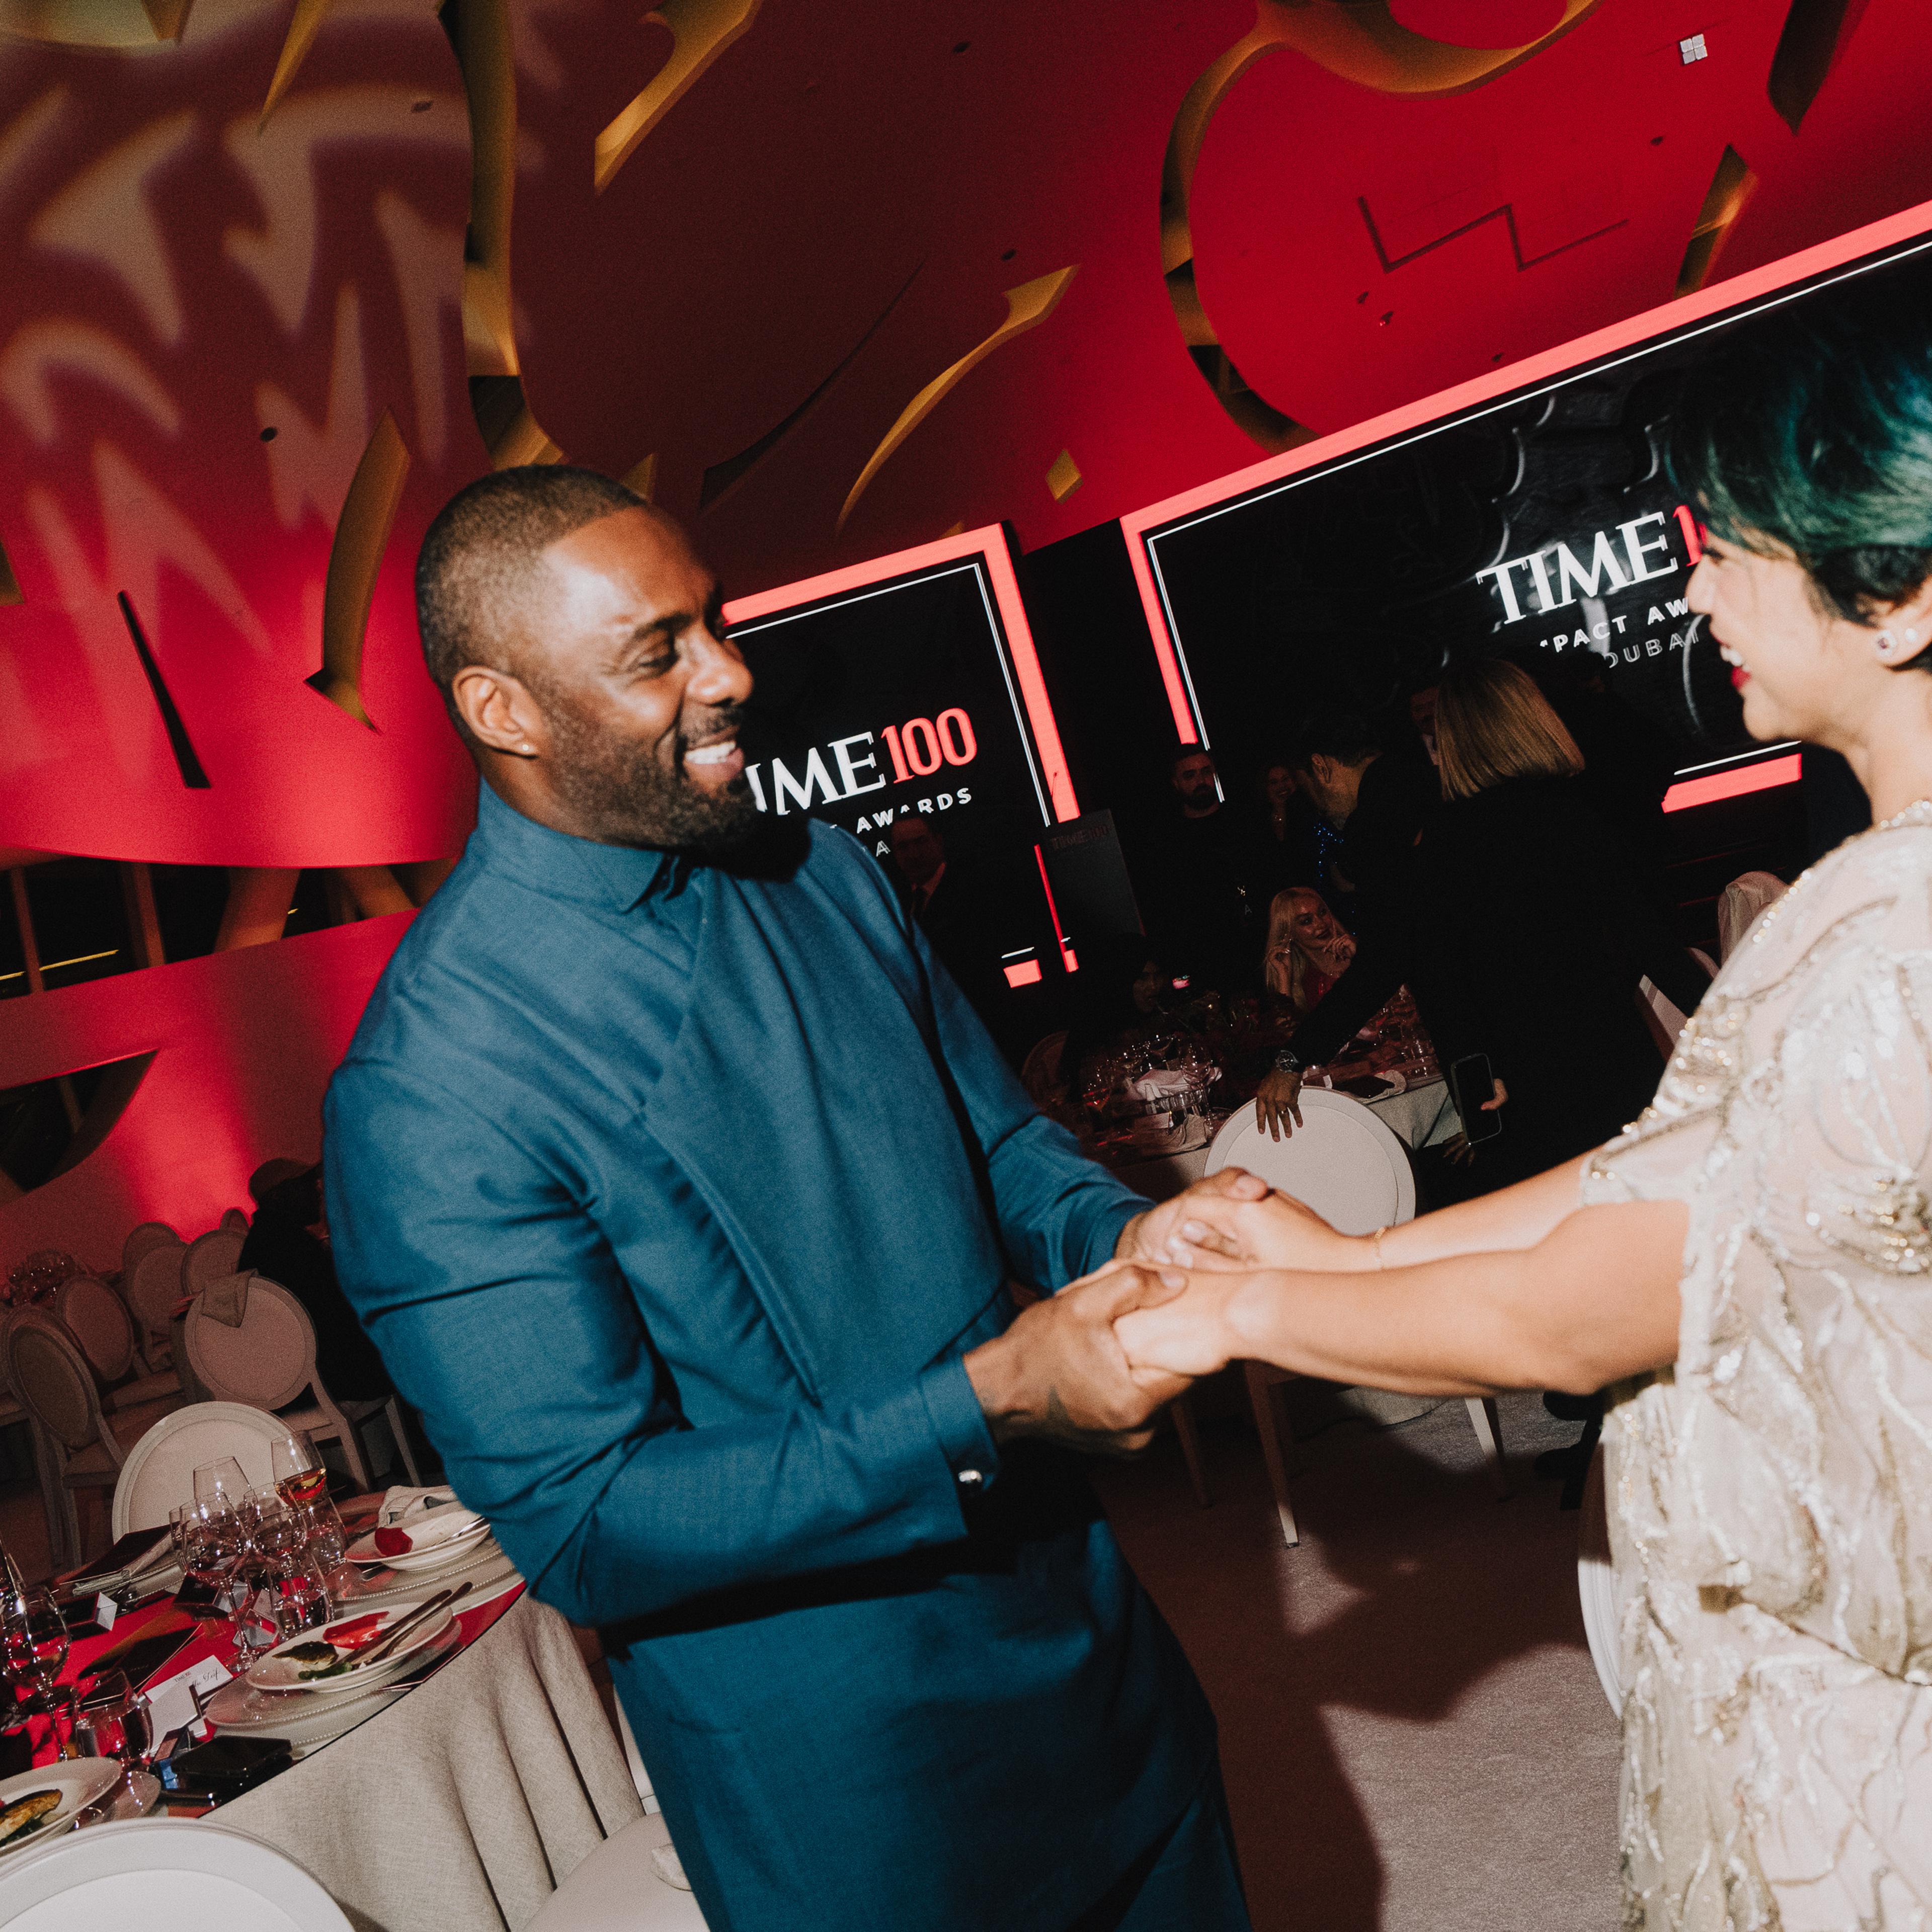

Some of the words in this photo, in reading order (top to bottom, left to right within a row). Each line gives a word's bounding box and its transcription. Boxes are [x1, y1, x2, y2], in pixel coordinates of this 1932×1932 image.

[1475, 505, 1708, 624] TIME1
[1540, 615, 1628, 653] PACT
[745, 707, 978, 816] IME100
